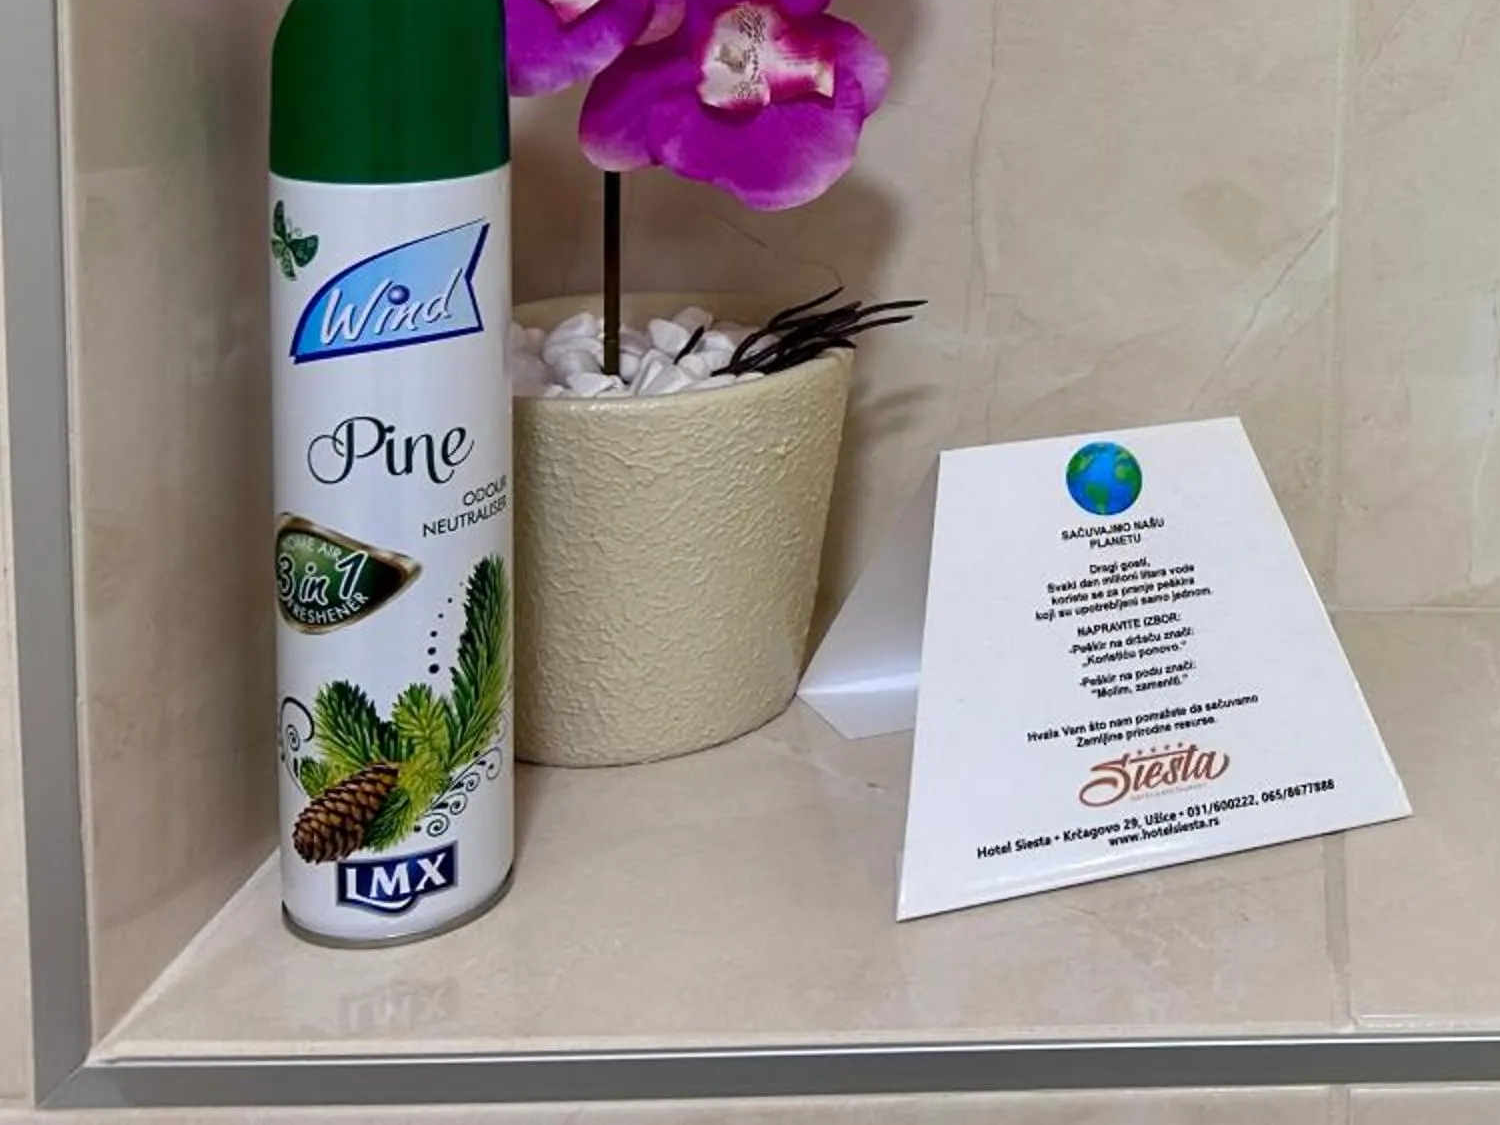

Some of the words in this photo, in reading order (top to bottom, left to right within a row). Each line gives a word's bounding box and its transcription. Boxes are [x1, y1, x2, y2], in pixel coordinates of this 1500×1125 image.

[320, 268, 463, 345] Wind
[307, 416, 474, 484] Pine
[1061, 523, 1131, 540] SAČUVAJMO
[1134, 517, 1165, 530] NAŠU
[1089, 534, 1141, 549] PLANETU
[278, 553, 296, 601] 3
[300, 561, 330, 605] in
[335, 550, 368, 600] 1
[1089, 561, 1118, 575] Dragi
[1047, 579, 1076, 594] Svaki
[1080, 578, 1100, 589] dan
[1091, 590, 1104, 600] se
[1106, 588, 1119, 598] za
[1035, 608, 1056, 622] koji
[1141, 593, 1170, 606] samo
[1077, 618, 1141, 636] NAPRAVITE
[1109, 639, 1123, 649] na
[1119, 672, 1133, 682] na
[1027, 730, 1059, 743] Hvala
[1061, 724, 1087, 737] Vam
[1089, 718, 1107, 732] što
[1109, 716, 1133, 730] nam
[1135, 707, 1187, 725] pomažete
[1189, 702, 1203, 714] da
[1205, 694, 1259, 712] sačuvamo
[1076, 731, 1123, 748] Zemljine
[1126, 722, 1172, 741] prirodne
[1078, 744, 1230, 807] Siesta
[977, 841, 1012, 859] Hotel
[1015, 835, 1052, 852] Siesta
[1063, 821, 1121, 842] Krčagovo
[1123, 817, 1143, 831] 29,
[1144, 810, 1177, 827] Užice
[1108, 816, 1220, 846] www.hotelsiesta.rs
[345, 852, 447, 908] LMX
